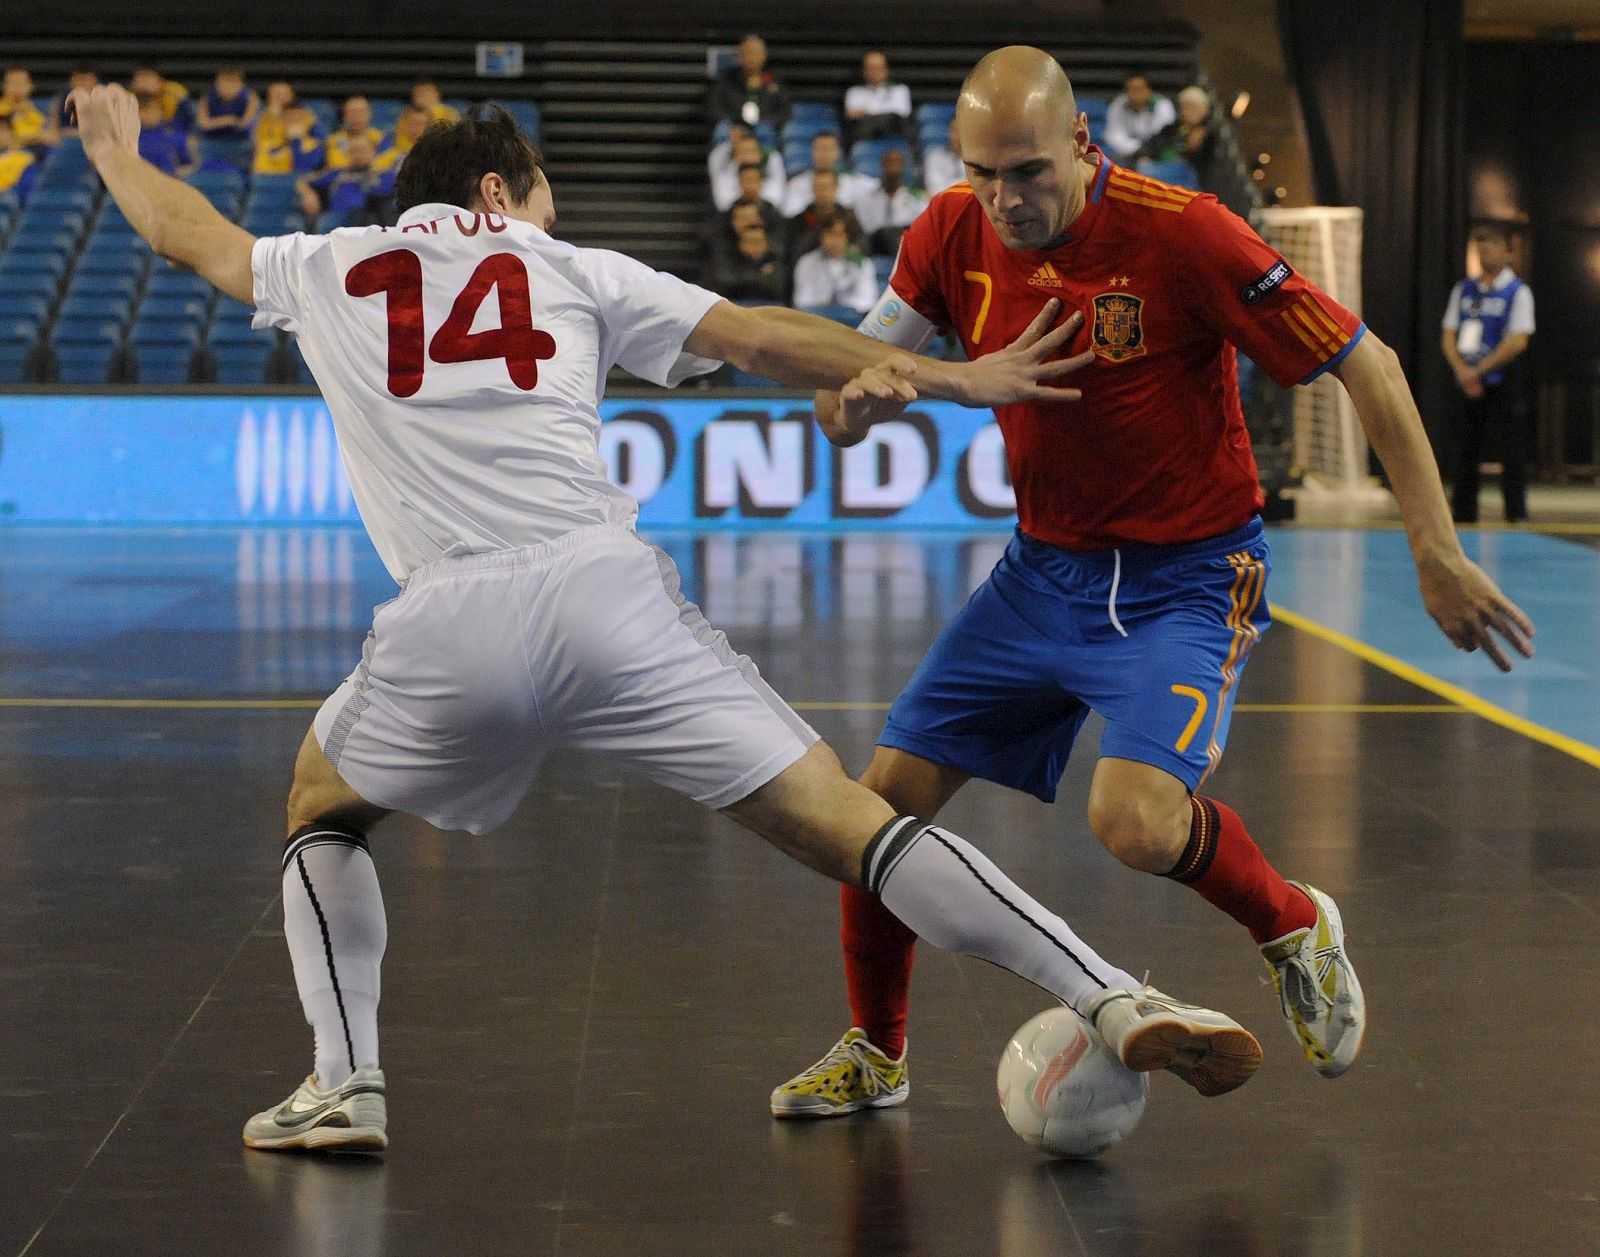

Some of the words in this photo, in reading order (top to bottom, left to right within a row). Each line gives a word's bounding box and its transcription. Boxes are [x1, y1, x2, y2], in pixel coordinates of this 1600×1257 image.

[963, 270, 992, 345] 7
[1027, 277, 1063, 288] adidas
[345, 248, 557, 398] 14
[1170, 684, 1208, 753] 7
